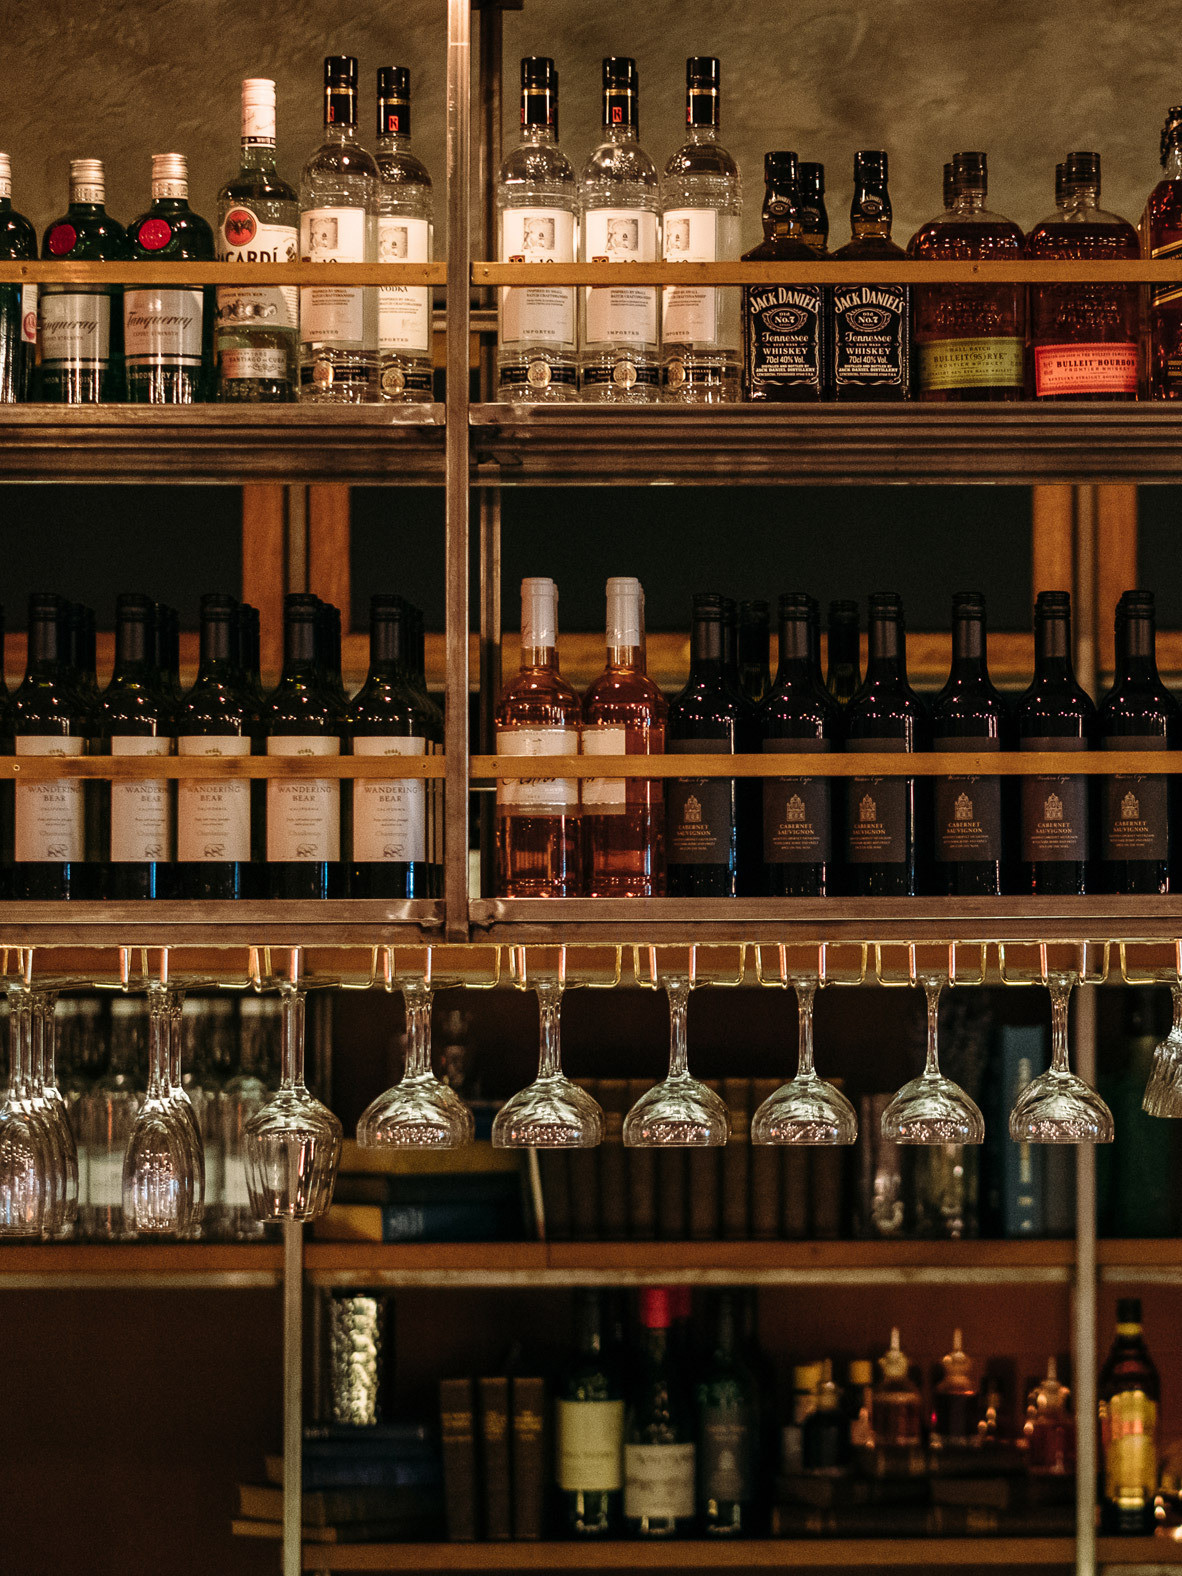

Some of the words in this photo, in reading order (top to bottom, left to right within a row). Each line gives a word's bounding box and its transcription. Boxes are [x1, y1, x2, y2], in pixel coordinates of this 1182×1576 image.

[218, 247, 278, 263] ACARDÍ
[750, 292, 778, 314] JACK
[778, 288, 822, 314] DANIEL'S
[834, 292, 861, 314] JACK
[862, 288, 905, 314] DANIEL'S
[127, 312, 193, 330] Tanqueray
[774, 316, 795, 324] No.7
[858, 316, 879, 324] No.7
[762, 332, 809, 342] Tennessee
[845, 332, 892, 342] Tennessee
[766, 356, 779, 364] 70cl
[780, 356, 794, 364] 40%
[794, 356, 805, 364] Vol.
[849, 356, 862, 364] 70cl
[863, 356, 877, 364] 40%
[877, 356, 888, 364] Vol.
[934, 354, 968, 363] BULLEIT
[1057, 360, 1093, 368] BULLEIT
